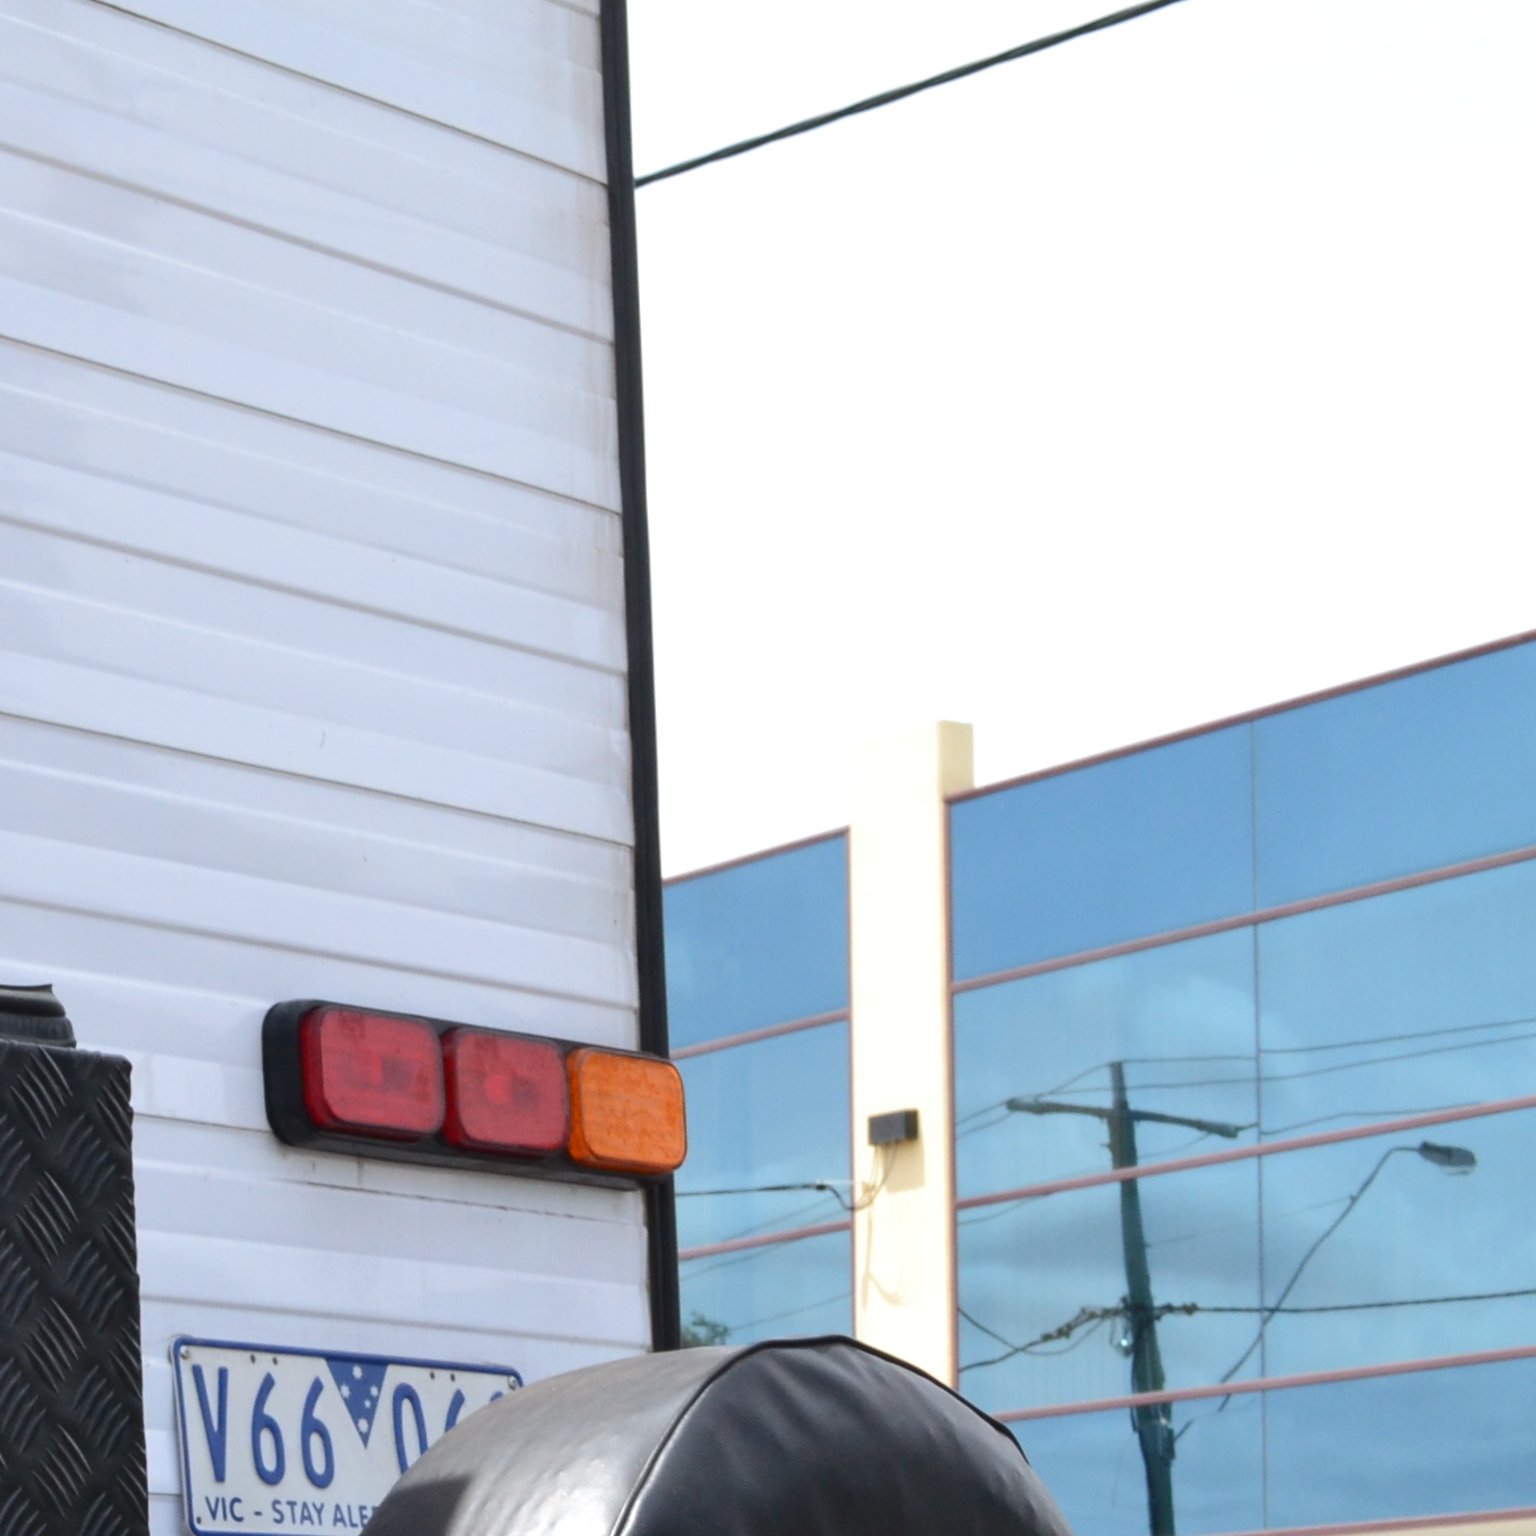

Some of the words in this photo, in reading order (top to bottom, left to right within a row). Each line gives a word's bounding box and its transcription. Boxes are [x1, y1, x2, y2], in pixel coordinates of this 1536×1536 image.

[191, 1364, 335, 1489] V66
[205, 1496, 245, 1522] VIC
[272, 1500, 326, 1527] STAY
[332, 1503, 382, 1529] ALE
